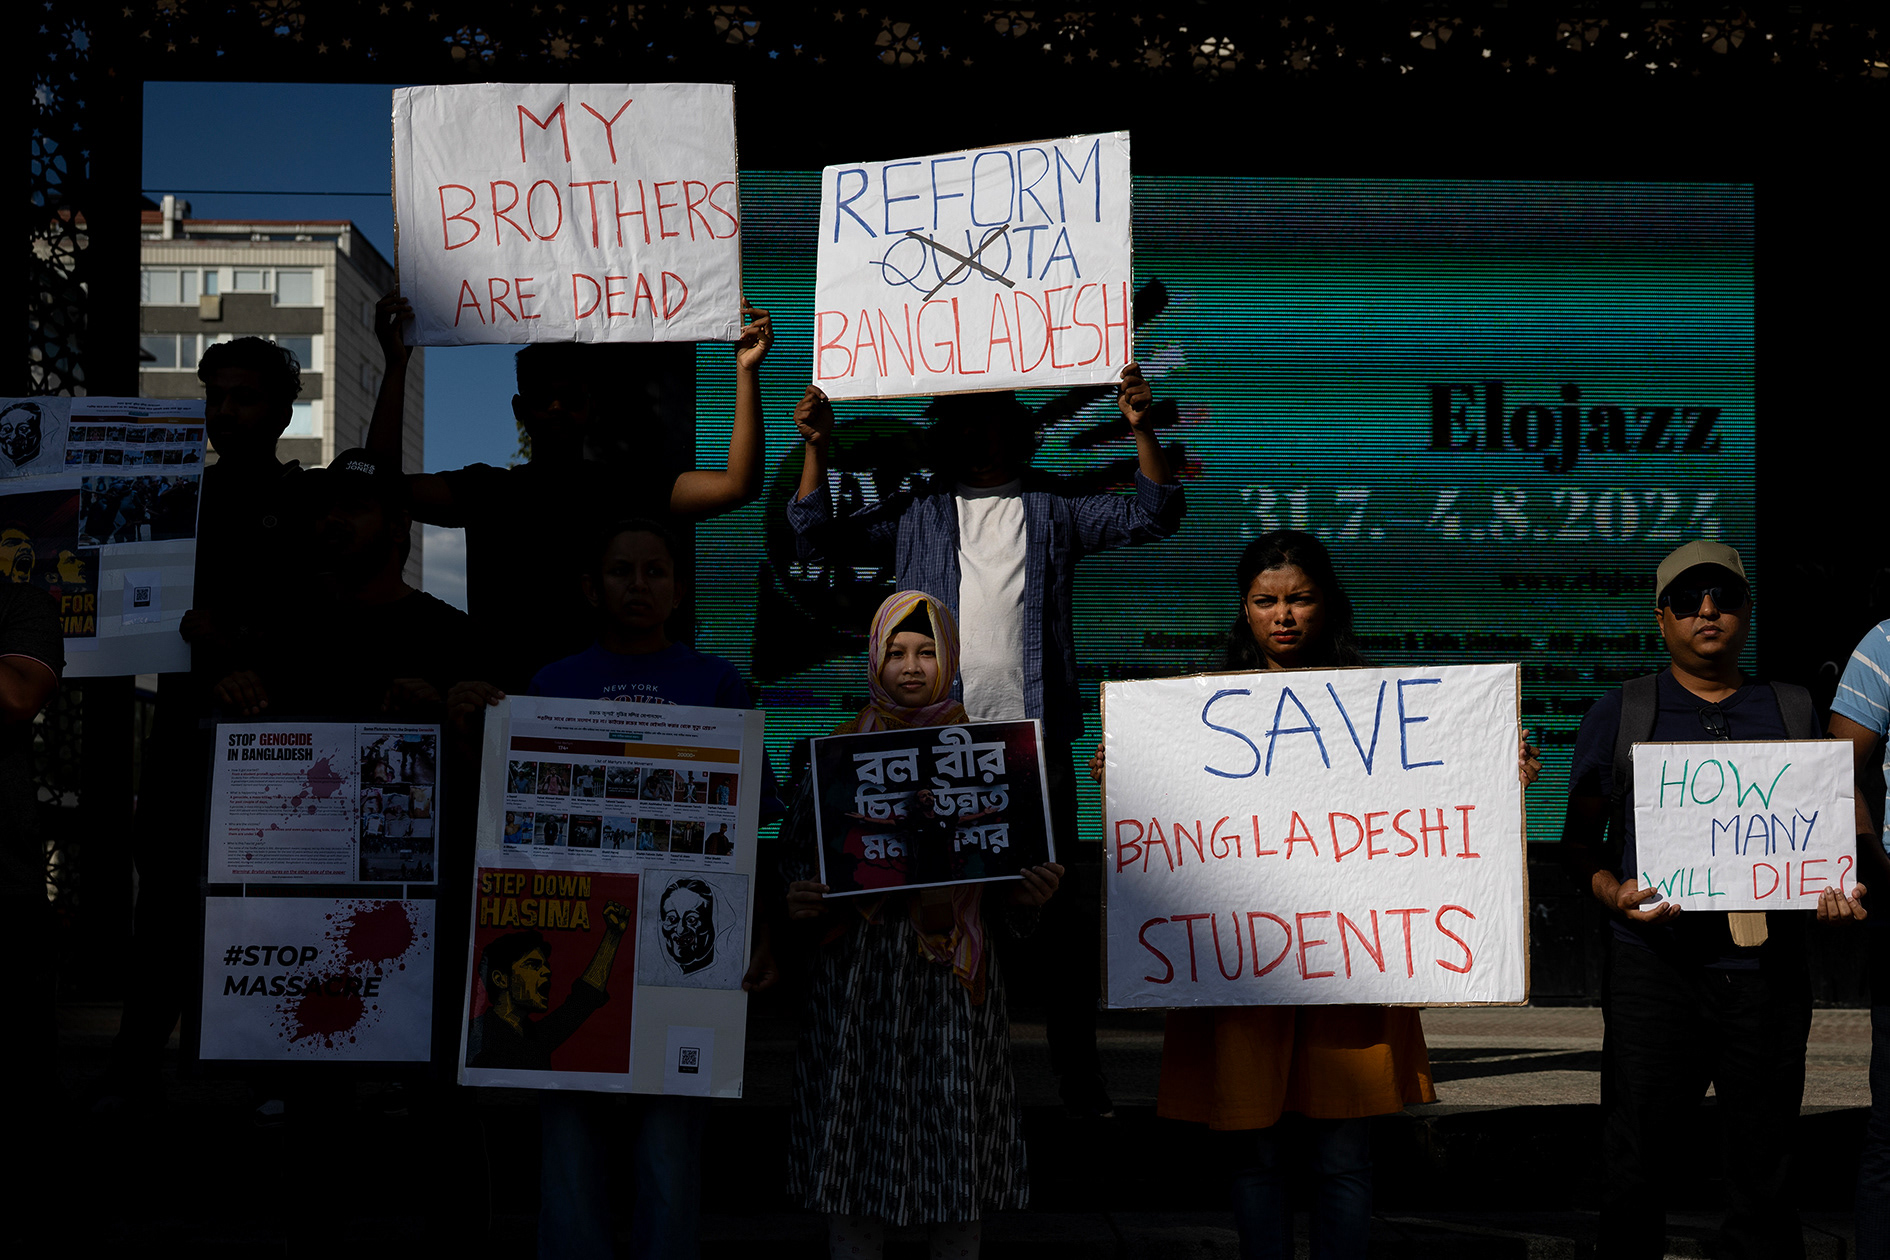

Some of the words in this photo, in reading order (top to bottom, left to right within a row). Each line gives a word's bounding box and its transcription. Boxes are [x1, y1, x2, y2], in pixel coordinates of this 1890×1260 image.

[517, 100, 633, 164] MY
[438, 179, 739, 250] BROTHERS
[835, 138, 1101, 244] REFORM
[869, 226, 1082, 294] QUOTA
[456, 277, 541, 327] ARE
[572, 271, 688, 322] DEAD
[815, 281, 1128, 381] BANGLADESH
[1428, 380, 1723, 474] Elojazz
[345, 465, 374, 475] JONES
[61, 593, 95, 614] FOR
[603, 684, 627, 693] NEW
[631, 684, 659, 692] YORK
[229, 733, 256, 746] STOP
[260, 733, 312, 746] GENOCIDE
[1201, 678, 1444, 779] SAVE
[227, 748, 239, 761] IN
[242, 748, 313, 761] BANGLADESH
[853, 747, 919, 786] বল
[932, 726, 1006, 784] বীর
[1660, 759, 1792, 810] HOW
[1114, 805, 1480, 873] BANGLADESHI
[1712, 808, 1819, 856] MANY
[481, 872, 526, 895] STEP
[532, 874, 592, 898] DOWN
[1643, 868, 1726, 898] WILL
[1753, 855, 1854, 900] DIE?
[479, 896, 592, 930] HASINA
[223, 945, 318, 966] #STOP
[1138, 904, 1477, 984] STUDENTS
[223, 975, 382, 998] MASSACRE
